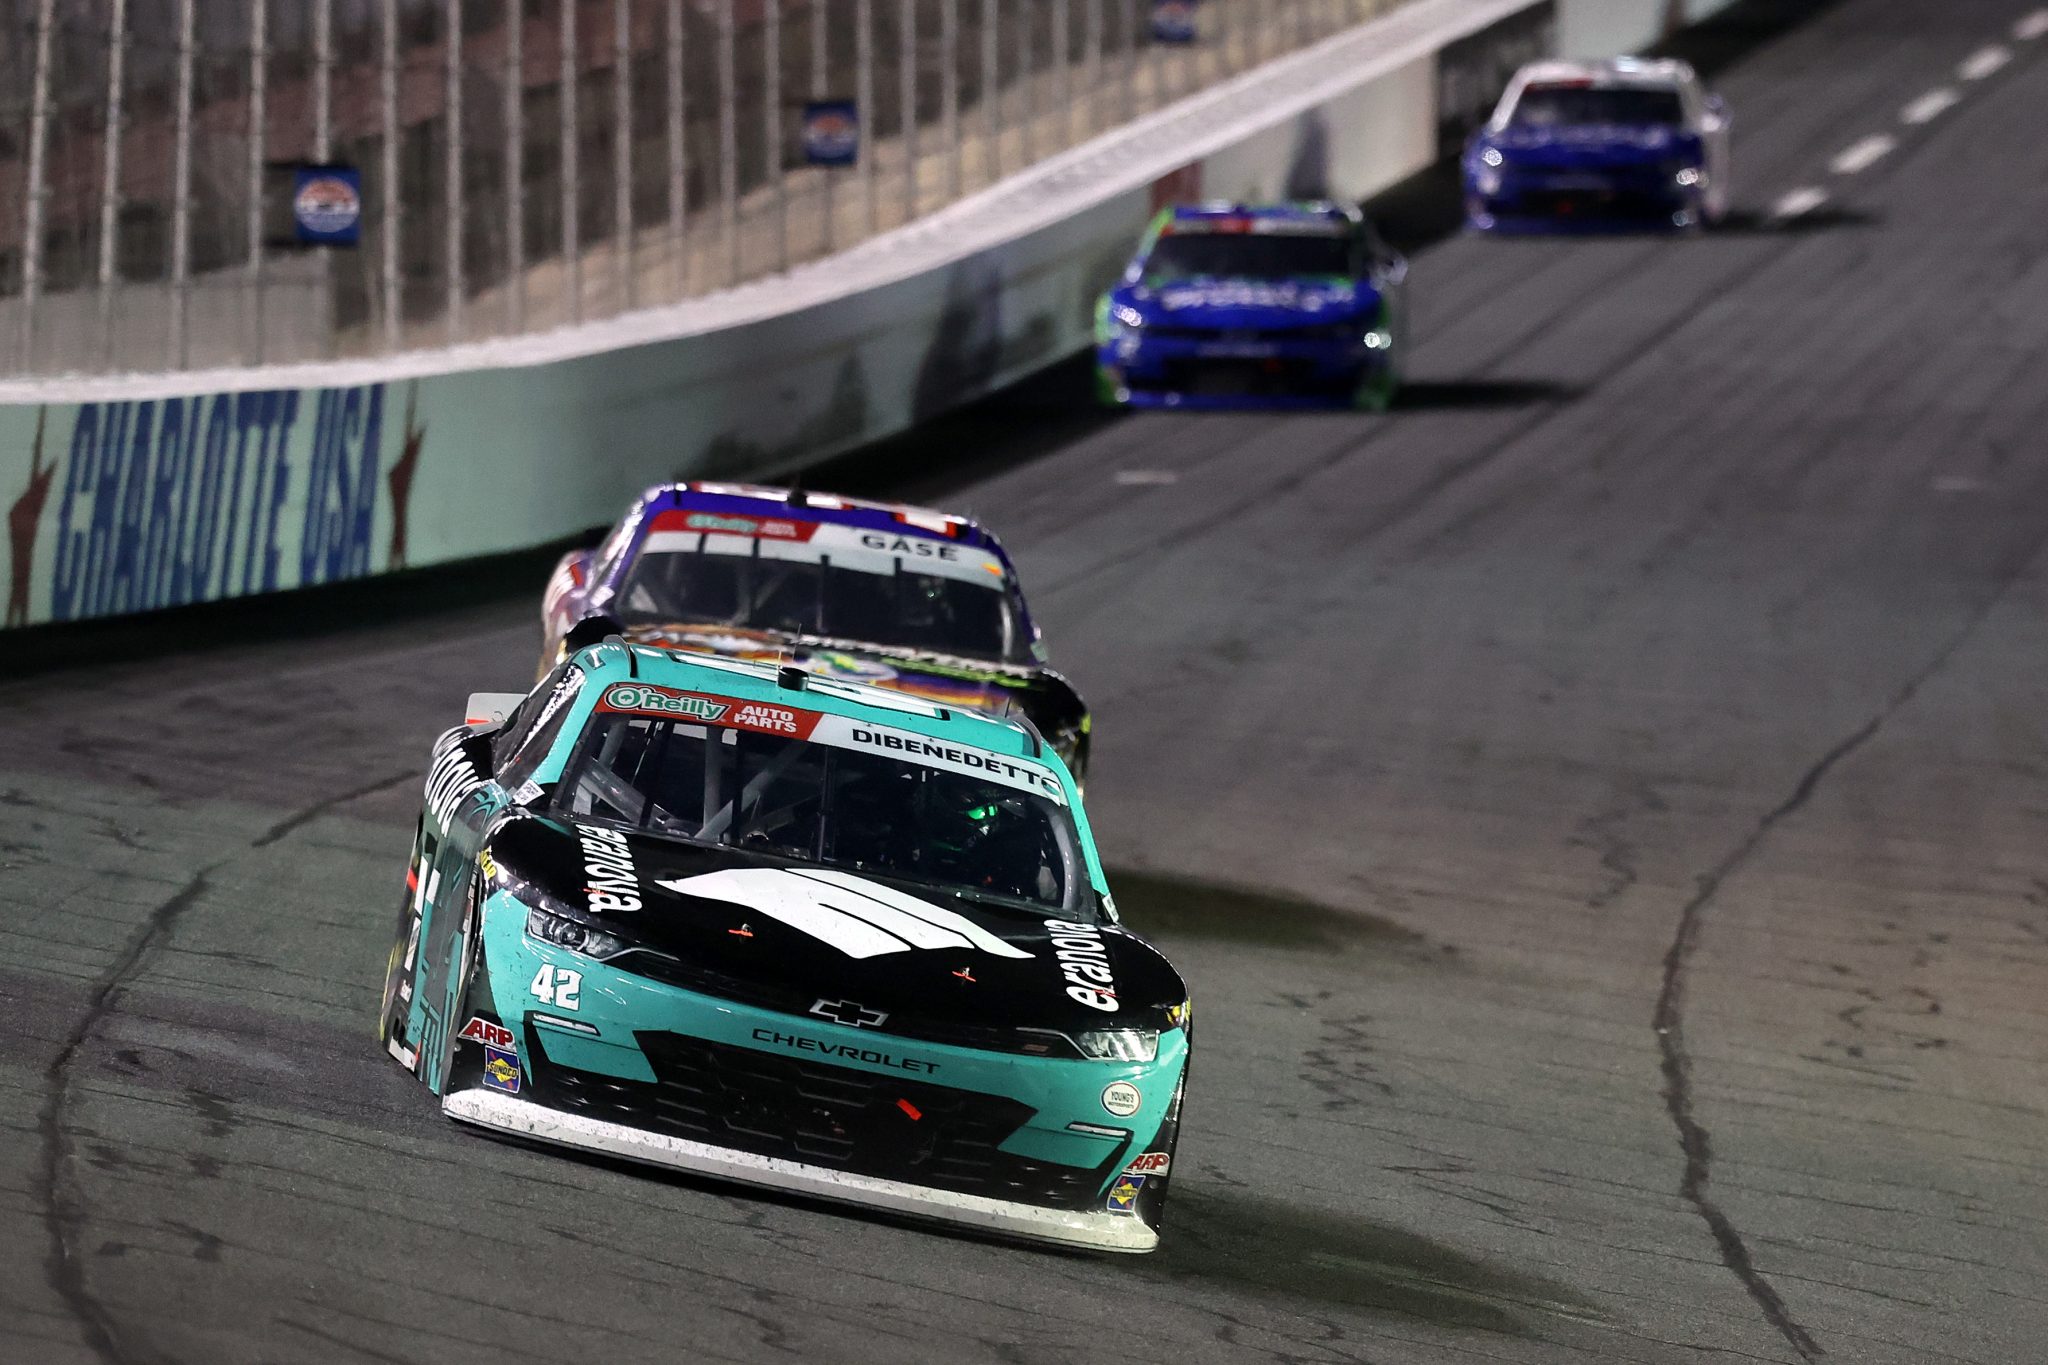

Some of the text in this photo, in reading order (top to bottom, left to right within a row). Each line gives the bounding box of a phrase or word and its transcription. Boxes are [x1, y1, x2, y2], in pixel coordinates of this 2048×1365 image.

[861, 534, 958, 562] GASE
[608, 687, 728, 722] O'Reilly
[741, 704, 795, 722] AUTO
[733, 713, 798, 733] PARTS
[852, 728, 1061, 796] DIBENEDETTO
[1043, 919, 1120, 1013] eranova
[531, 963, 584, 1011] 42
[461, 1018, 514, 1047] ARP
[752, 1028, 941, 1075] CHEVROLET
[488, 1062, 518, 1079] SUNOCO
